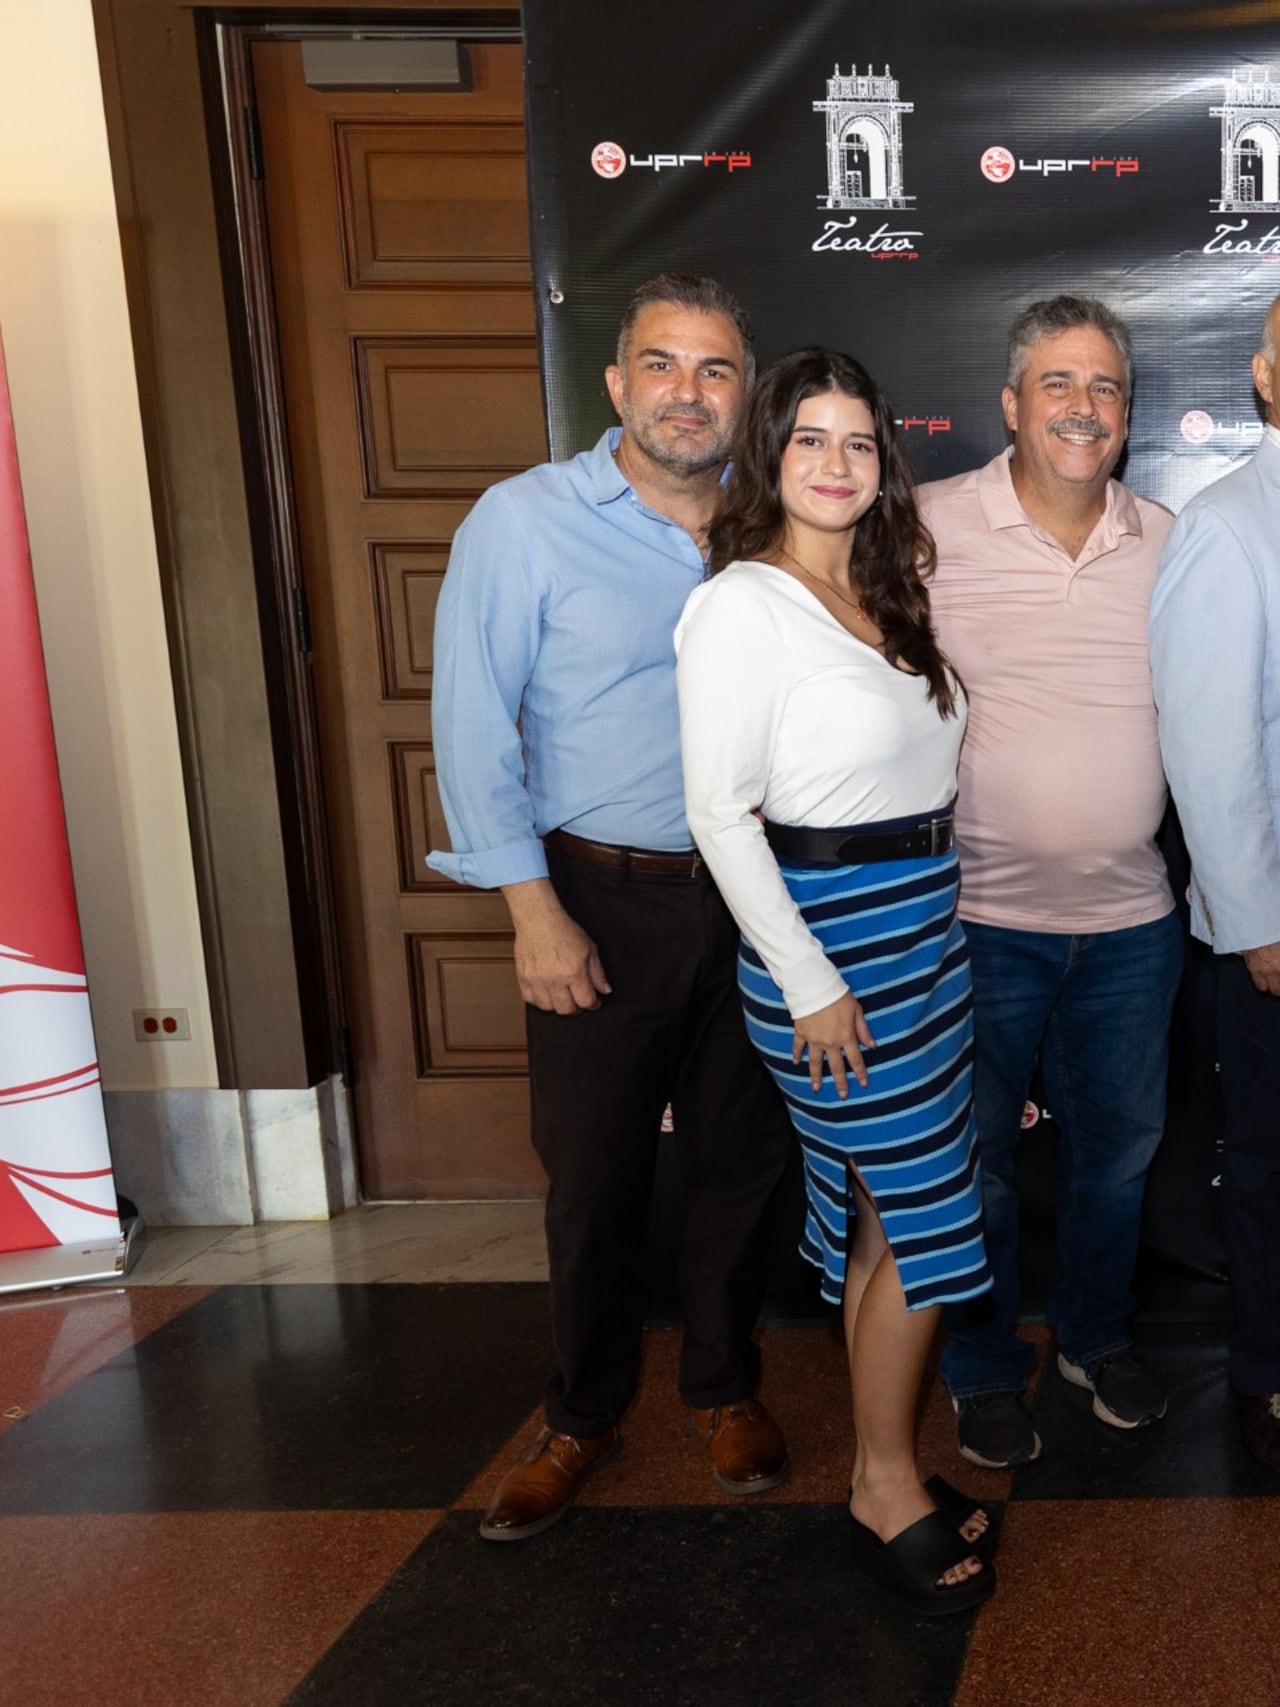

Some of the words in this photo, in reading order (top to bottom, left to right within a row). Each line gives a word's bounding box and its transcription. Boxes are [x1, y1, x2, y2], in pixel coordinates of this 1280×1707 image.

[629, 153, 751, 173] uprrp
[1018, 158, 1140, 178] uprrp
[811, 215, 924, 252] Teatro
